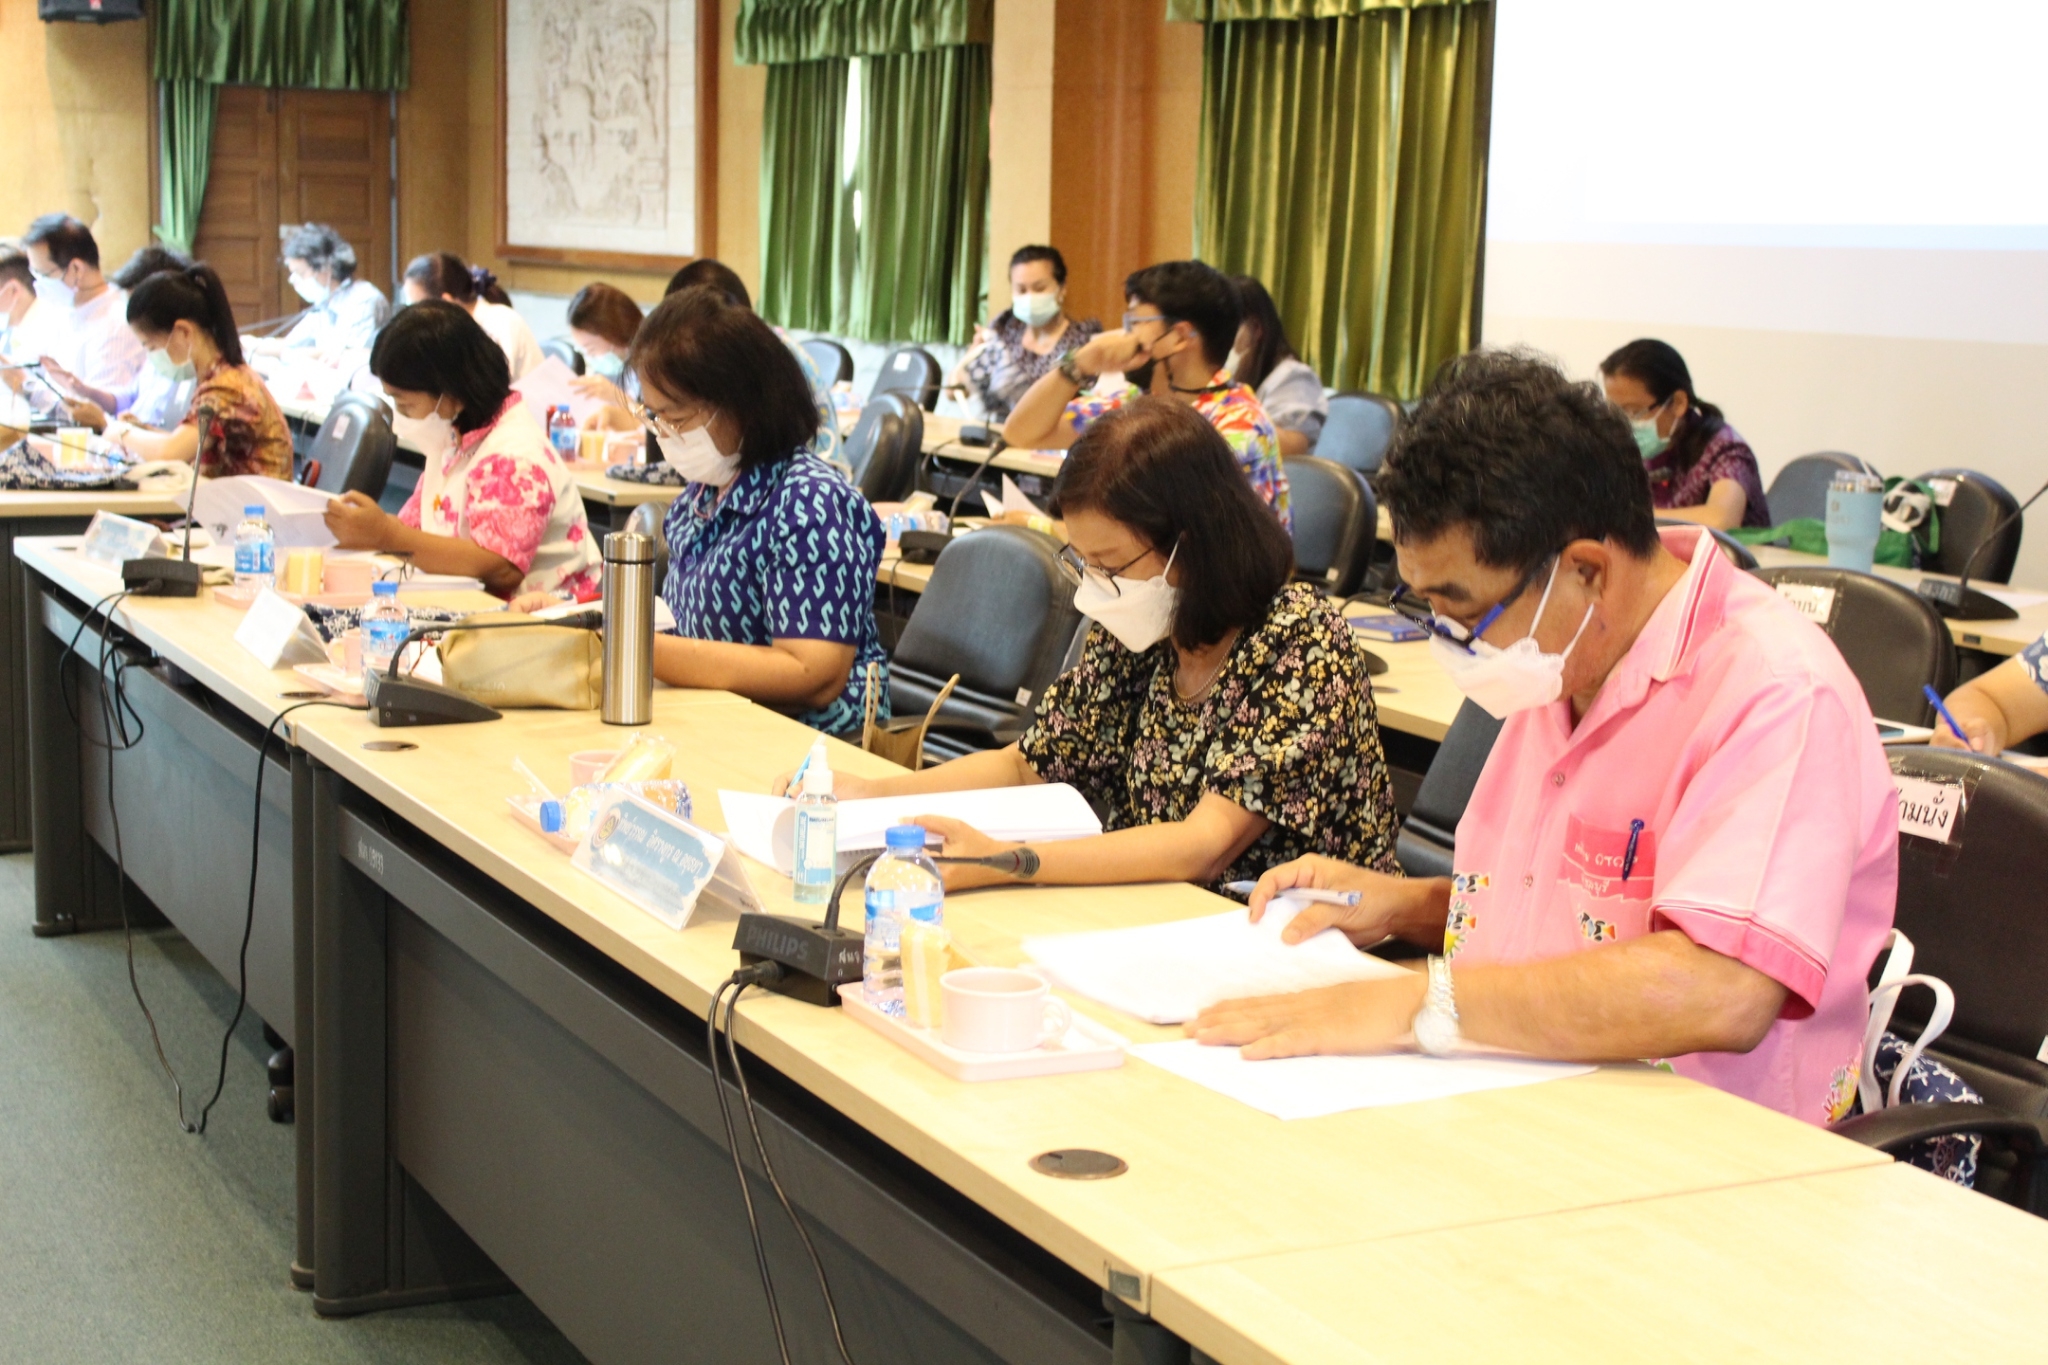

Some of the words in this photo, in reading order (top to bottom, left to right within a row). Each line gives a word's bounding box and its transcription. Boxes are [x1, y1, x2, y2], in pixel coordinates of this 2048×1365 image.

[1898, 788, 1949, 829] ามนั่ง
[746, 924, 809, 960] PHILIPS
